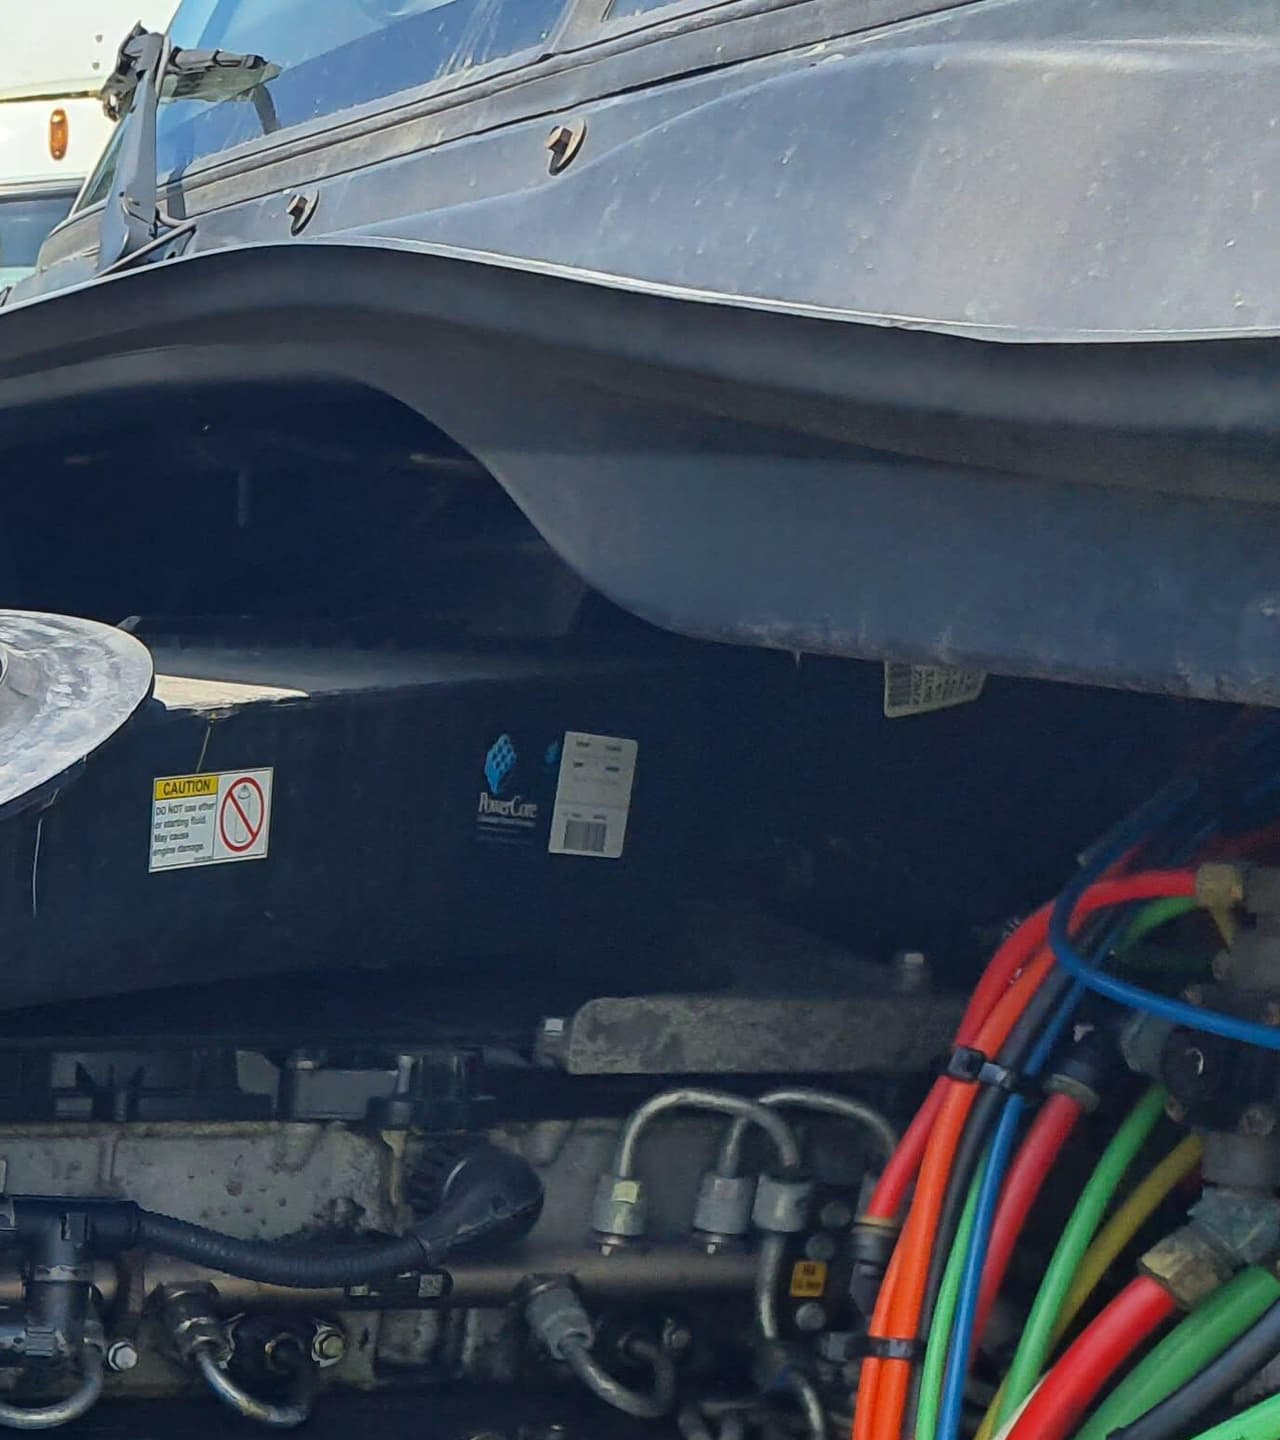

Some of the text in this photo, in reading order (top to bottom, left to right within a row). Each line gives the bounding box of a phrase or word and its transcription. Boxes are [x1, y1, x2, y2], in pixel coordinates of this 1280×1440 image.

[163, 780, 211, 796] CAUTION
[155, 806, 167, 816] DO
[168, 804, 184, 814] NOT
[478, 791, 538, 819] PowerCore
